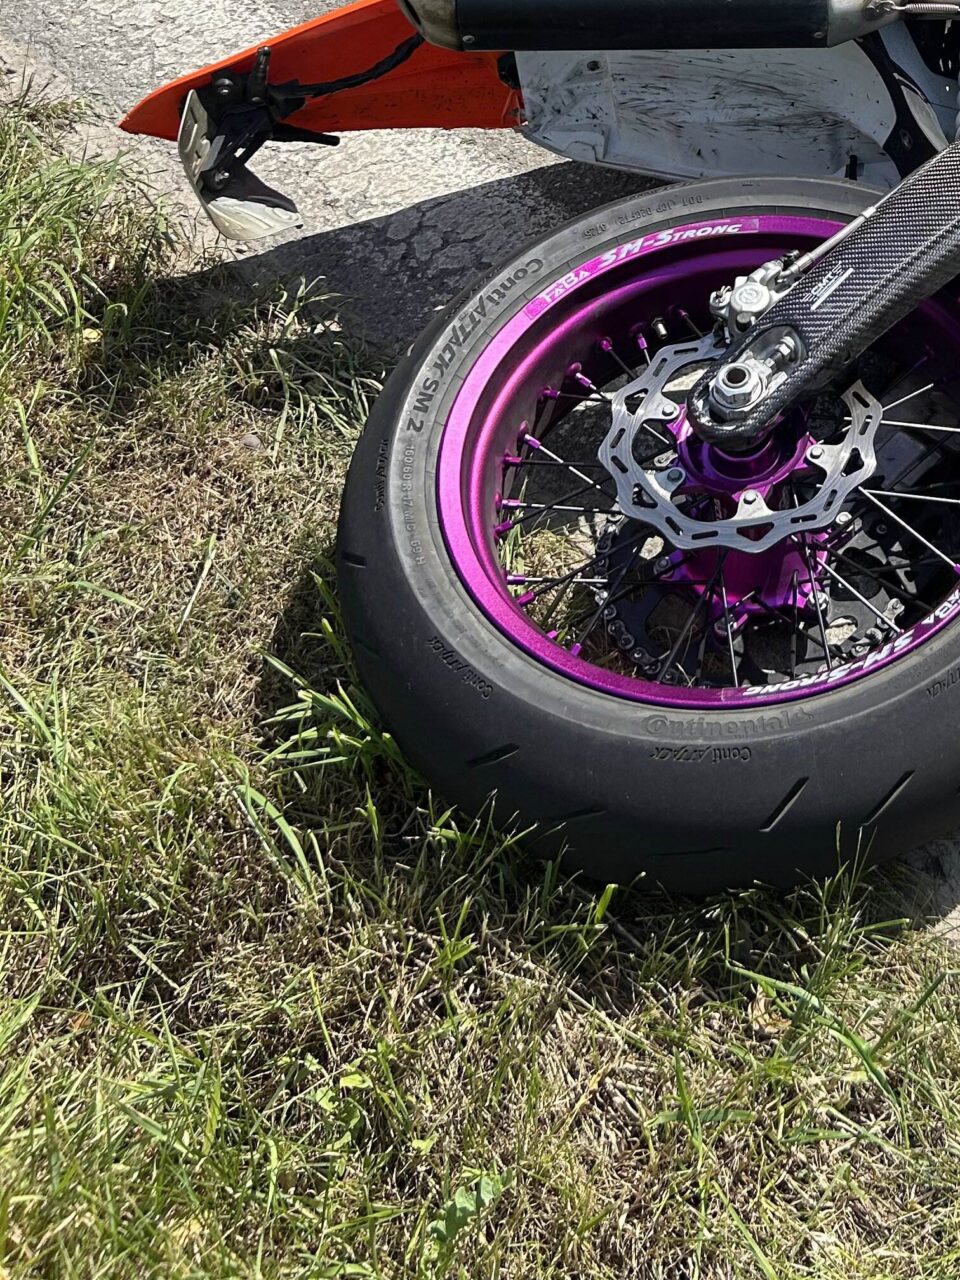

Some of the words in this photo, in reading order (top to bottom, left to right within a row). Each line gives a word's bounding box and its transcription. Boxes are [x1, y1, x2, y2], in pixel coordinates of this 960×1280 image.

[418, 377, 439, 414] SM
[406, 419, 424, 433] 2
[401, 445, 416, 480] 160/60
[645, 710, 791, 736] Continental
